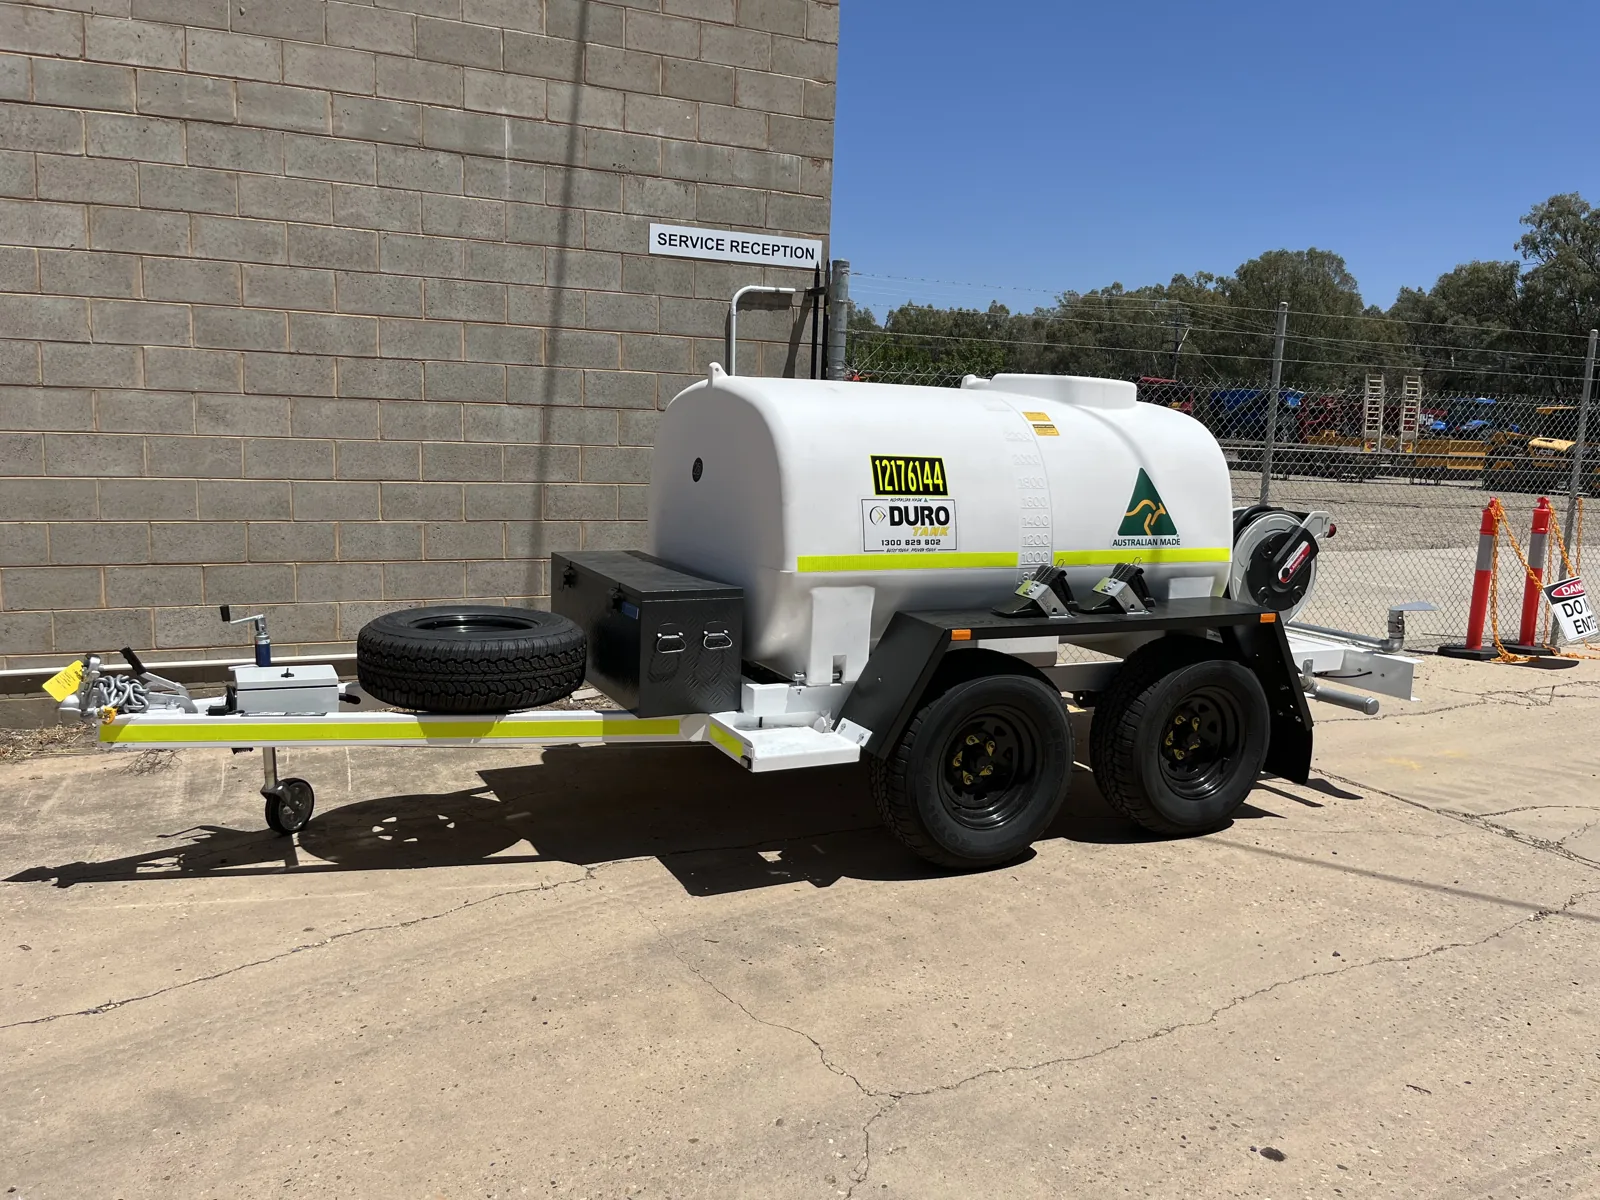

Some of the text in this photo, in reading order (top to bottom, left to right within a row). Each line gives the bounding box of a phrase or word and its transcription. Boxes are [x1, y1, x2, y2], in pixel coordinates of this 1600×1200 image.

[657, 232, 815, 260] SERVICE RECEPTION
[875, 459, 944, 492] 12176144
[1018, 476, 1045, 488] 1800
[1021, 496, 1047, 508] 1600
[889, 506, 950, 526] DURO
[1022, 515, 1049, 527] 1400
[912, 527, 949, 536] TANK
[1022, 534, 1049, 546] 1200
[1021, 551, 1049, 563] 1000
[1561, 600, 1583, 618] DO
